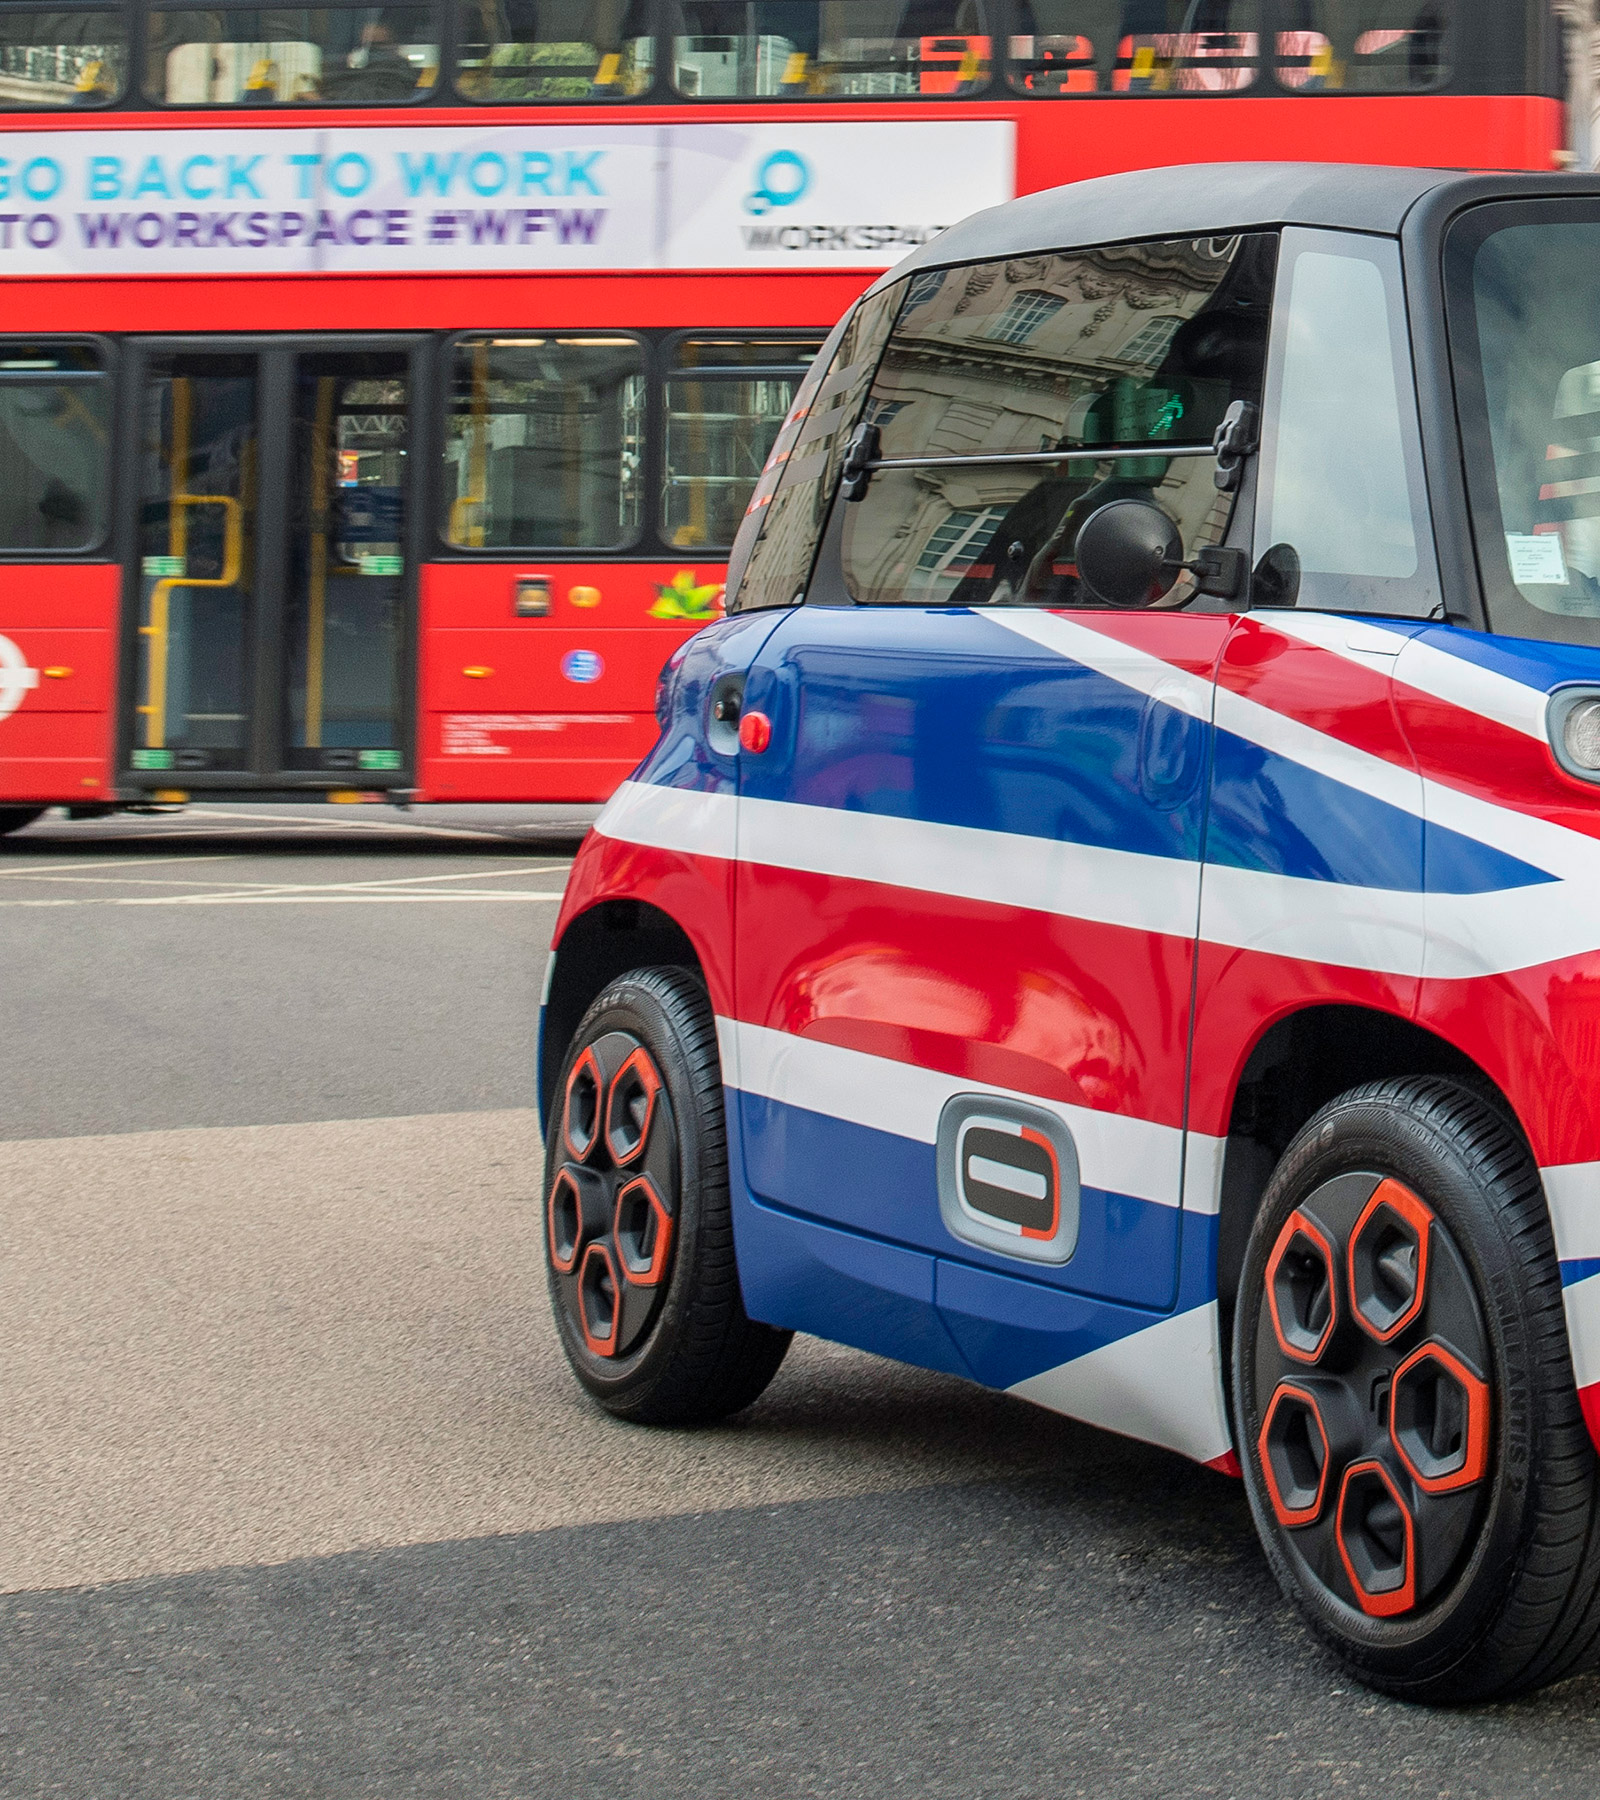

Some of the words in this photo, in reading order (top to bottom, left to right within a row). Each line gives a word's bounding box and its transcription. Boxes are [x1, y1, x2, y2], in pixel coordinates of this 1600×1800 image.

[85, 154, 266, 200] BACK
[284, 151, 373, 199] TO
[397, 151, 607, 198] WORK
[76, 210, 413, 249] WORKSPACE
[427, 208, 608, 246] #WFW
